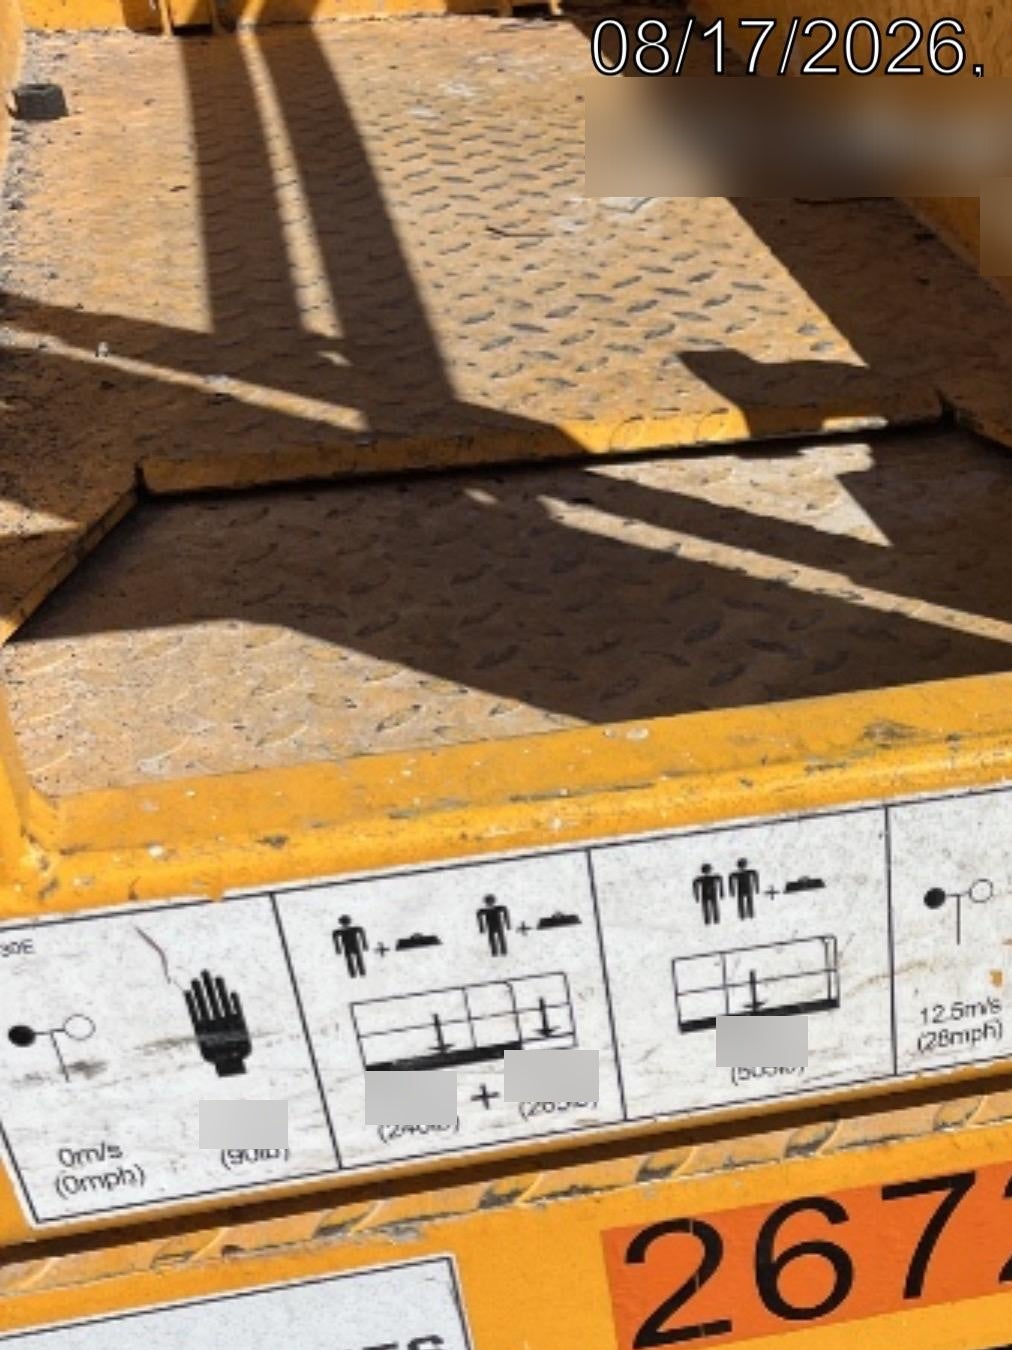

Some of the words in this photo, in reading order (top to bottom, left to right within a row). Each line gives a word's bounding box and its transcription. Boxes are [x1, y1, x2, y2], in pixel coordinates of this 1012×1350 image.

[920, 996, 1003, 1026] 12.5m/s
[917, 1019, 1003, 1053] (28mph)
[57, 1141, 124, 1168] 0m/s
[54, 1163, 147, 1200] (0mph)
